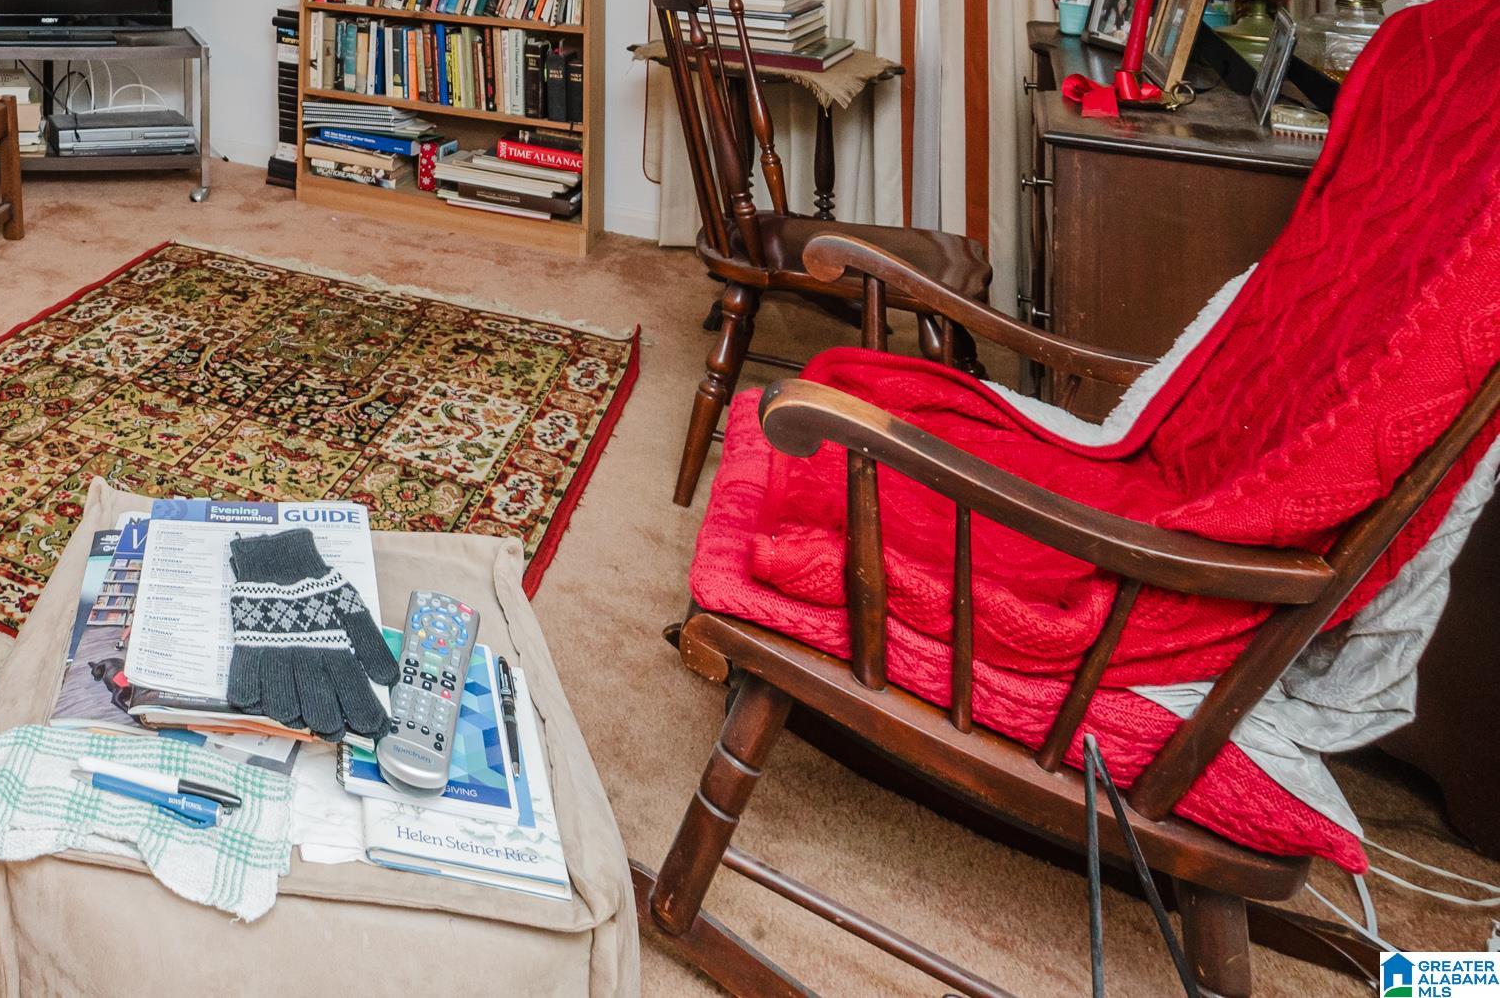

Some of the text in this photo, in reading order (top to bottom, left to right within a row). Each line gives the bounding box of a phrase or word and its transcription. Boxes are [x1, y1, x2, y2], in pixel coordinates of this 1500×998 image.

[508, 147, 582, 168] TIME ALMANAC
[210, 513, 273, 523] Programming
[211, 506, 259, 516] Evening
[284, 509, 361, 524] GUIDE
[397, 825, 539, 864] Helen Steiner Rice
